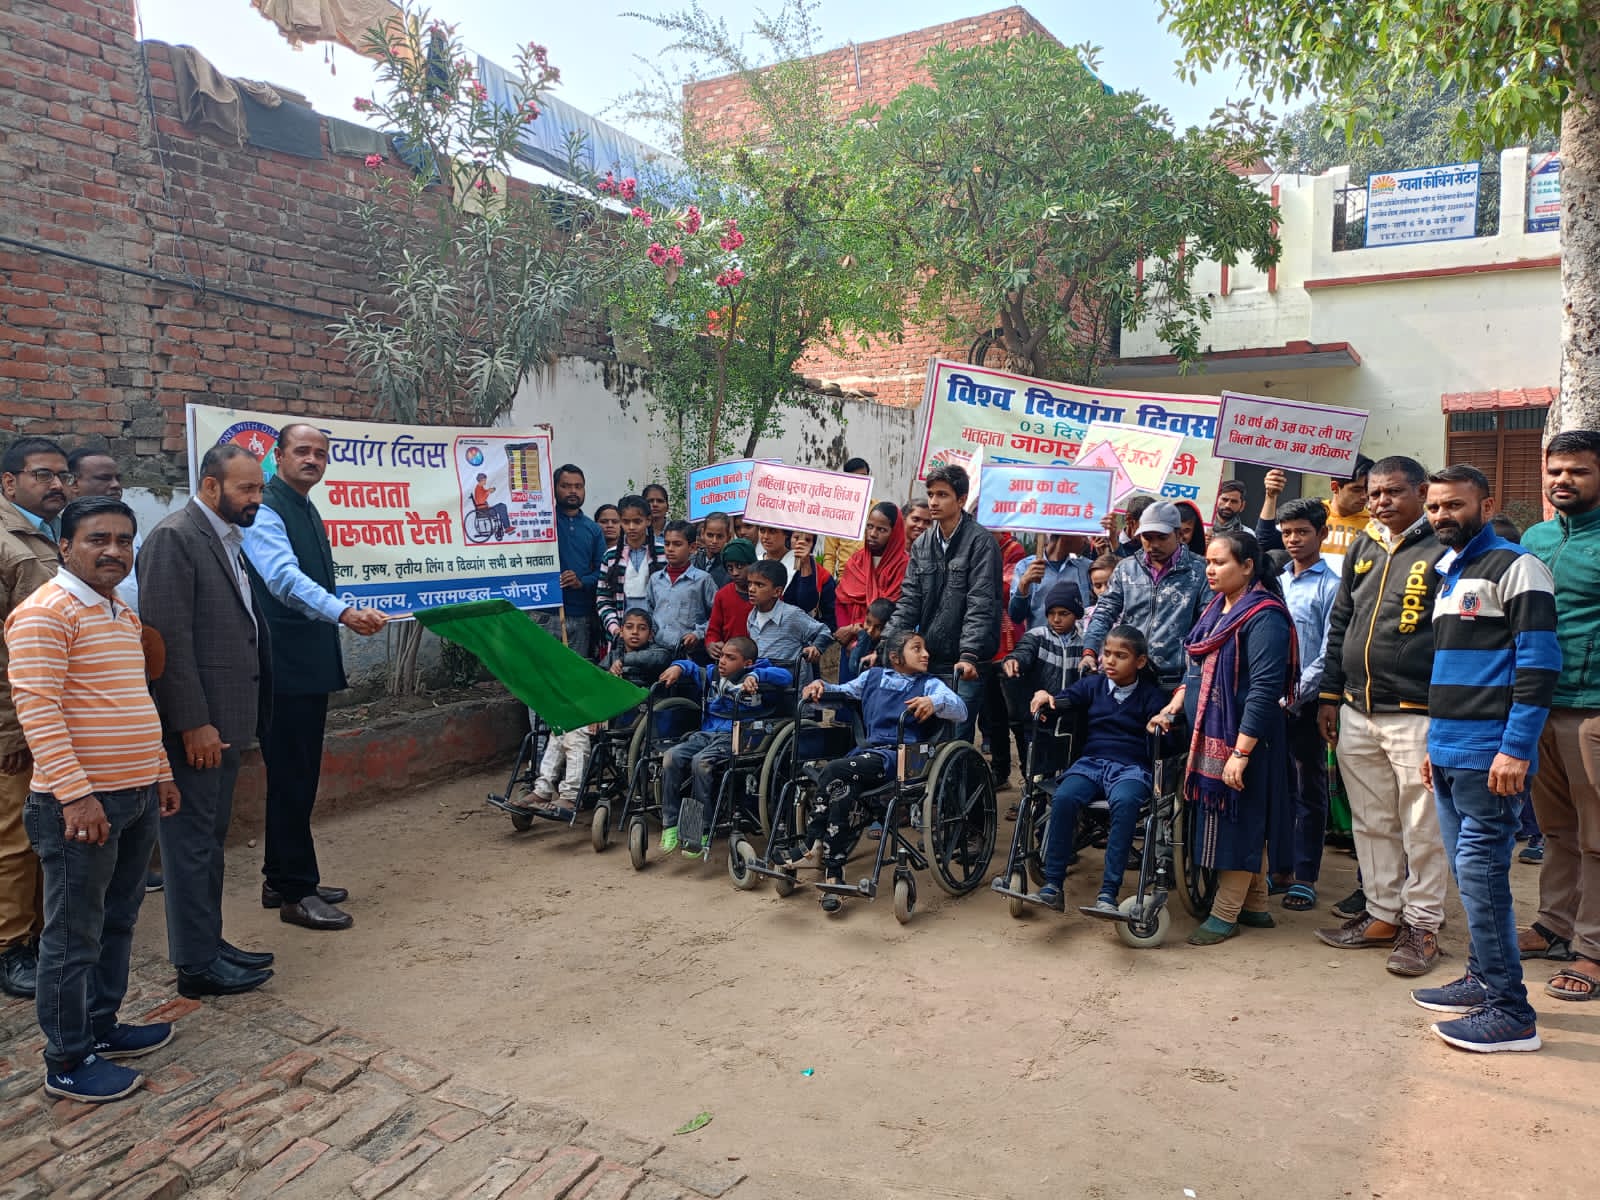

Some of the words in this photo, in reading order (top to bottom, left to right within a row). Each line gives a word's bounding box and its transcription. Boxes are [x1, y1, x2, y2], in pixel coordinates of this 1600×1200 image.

[1397, 177, 1423, 191] रचना
[1423, 169, 1454, 189] कोचिंग
[1454, 167, 1478, 185] सेंटर
[946, 373, 1016, 411] विश्व
[1024, 387, 1126, 424] दिव्यांग
[1136, 404, 1218, 439] दिवस
[962, 427, 1005, 447] मतदाता
[1020, 420, 1045, 434] 03
[1233, 413, 1247, 426] 18
[1247, 415, 1264, 428] वर्ष
[1264, 417, 1279, 431] की
[1280, 421, 1298, 434] उम्र
[1298, 424, 1318, 437] कर
[1318, 424, 1334, 440] ली
[1335, 429, 1354, 442] पार
[391, 435, 448, 468] दिवस
[1229, 429, 1254, 446] मिला
[1255, 434, 1272, 449] वोट
[1274, 439, 1289, 451] का
[1290, 441, 1308, 453] अब
[1309, 443, 1353, 460] अधिकार
[325, 480, 410, 508] मतदाता
[809, 482, 833, 499] तृतीय
[1008, 479, 1034, 492] आप
[1036, 480, 1053, 493] का
[756, 493, 786, 510] दिव्यांग
[787, 499, 806, 513] सभी
[821, 506, 856, 521] मतदाता
[991, 501, 1017, 513] आप
[1020, 498, 1038, 514] की
[1040, 502, 1081, 517] आवाज
[1083, 502, 1095, 519] है
[405, 511, 453, 544] रैली
[395, 558, 422, 578] तृतीय
[425, 557, 444, 573] लिंग
[447, 561, 454, 572] व
[456, 556, 486, 571] दिव्यांग
[488, 554, 507, 569] सभी
[509, 553, 524, 568] बने
[526, 554, 554, 567] मतदाता
[1398, 560, 1428, 633] adidas
